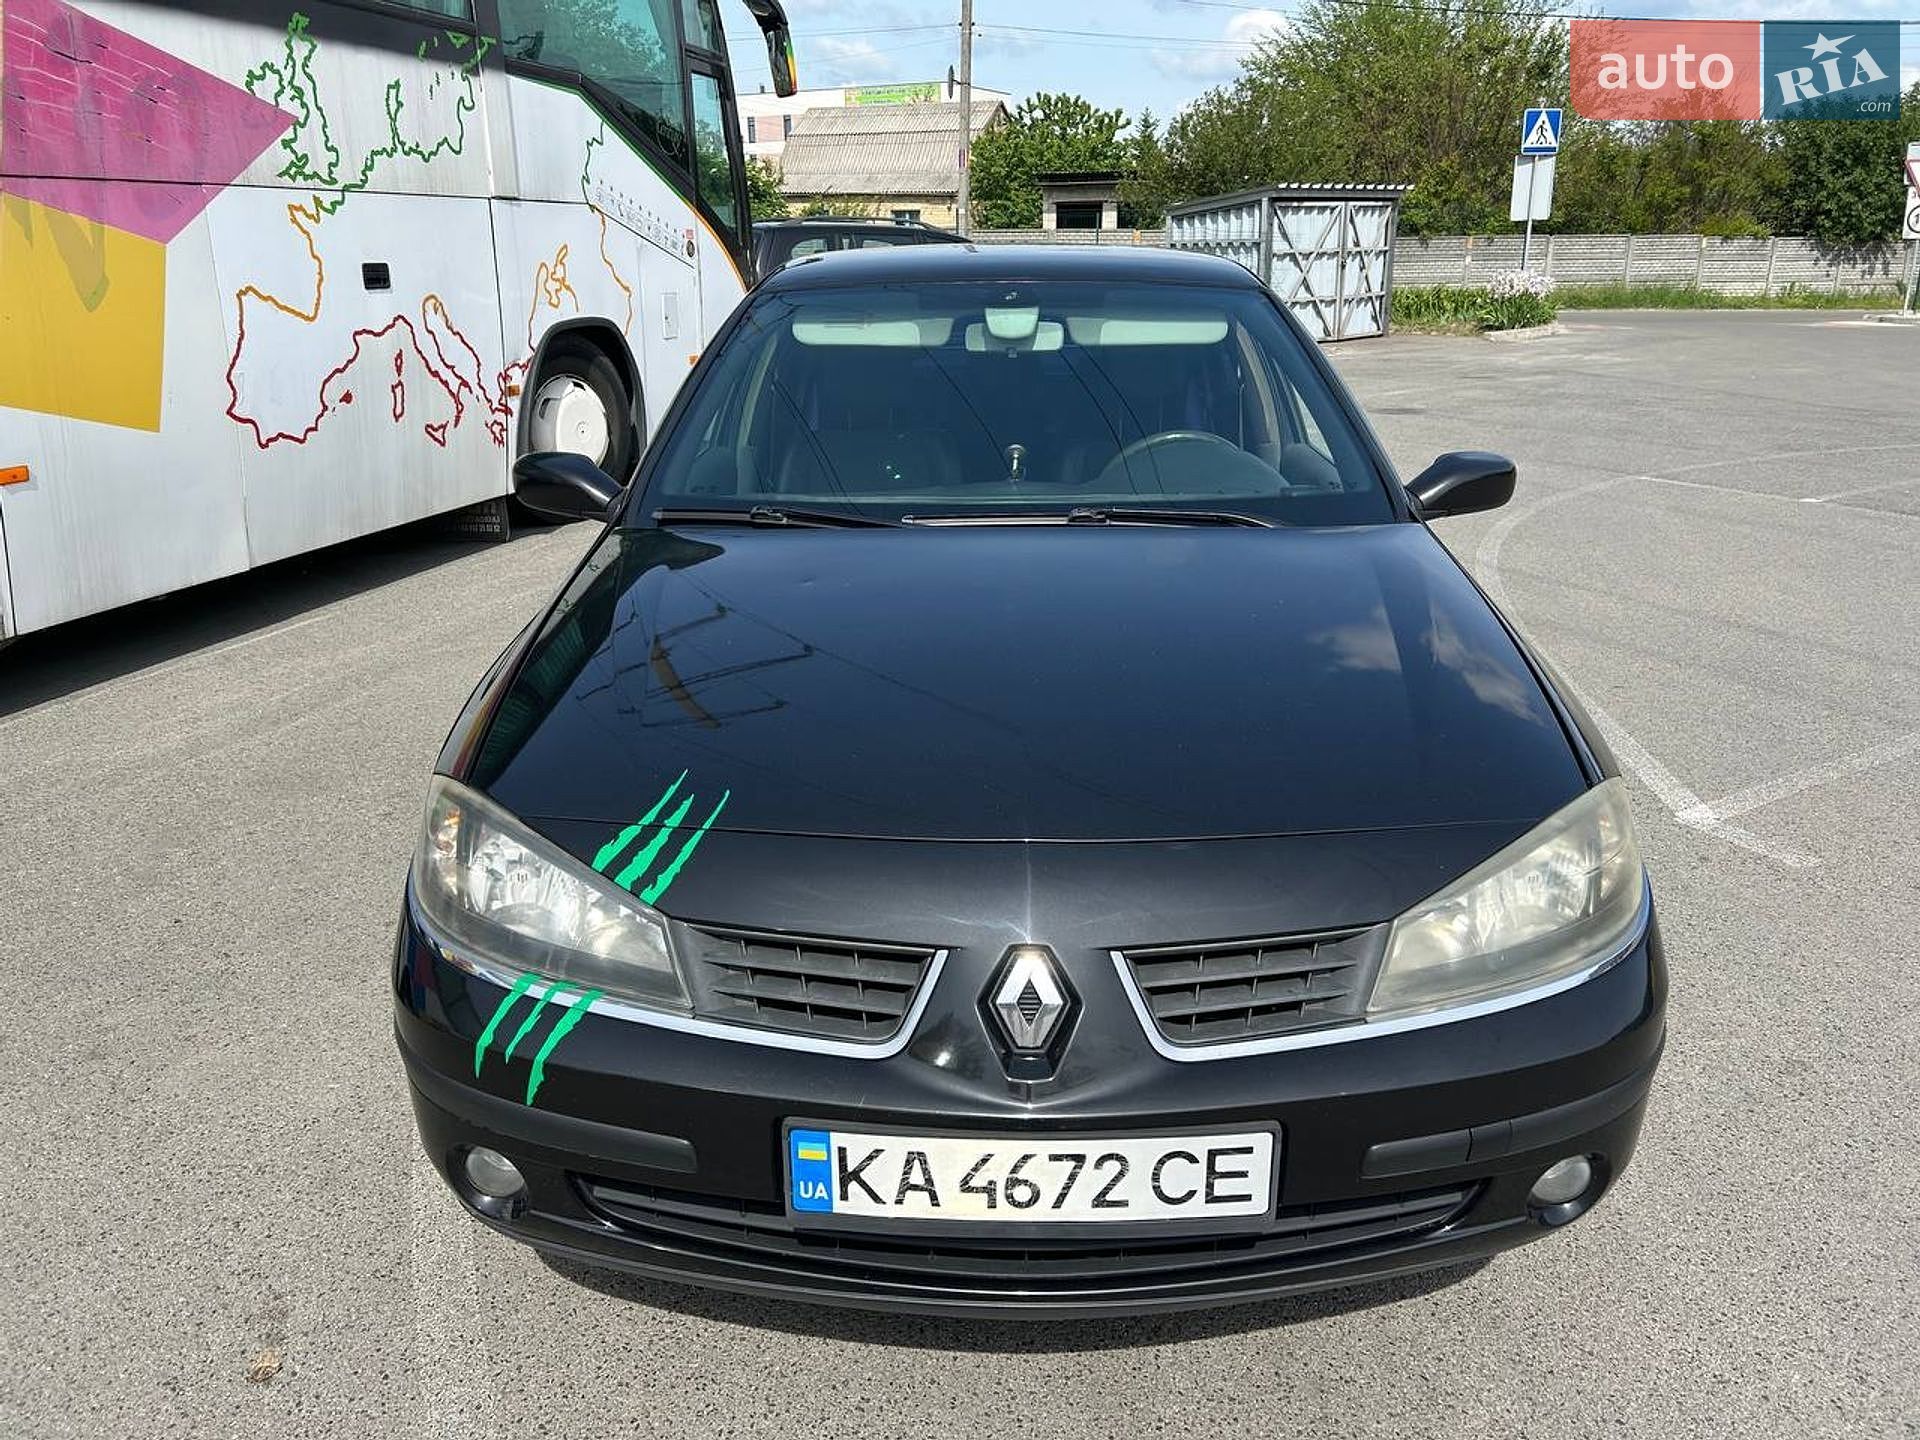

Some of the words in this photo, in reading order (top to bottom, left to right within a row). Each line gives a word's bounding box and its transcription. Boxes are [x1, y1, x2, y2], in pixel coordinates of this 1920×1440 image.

[799, 1180, 829, 1200] UA
[836, 1145, 941, 1208] KA
[959, 1151, 1130, 1210] 4672
[1151, 1145, 1255, 1206] CE
